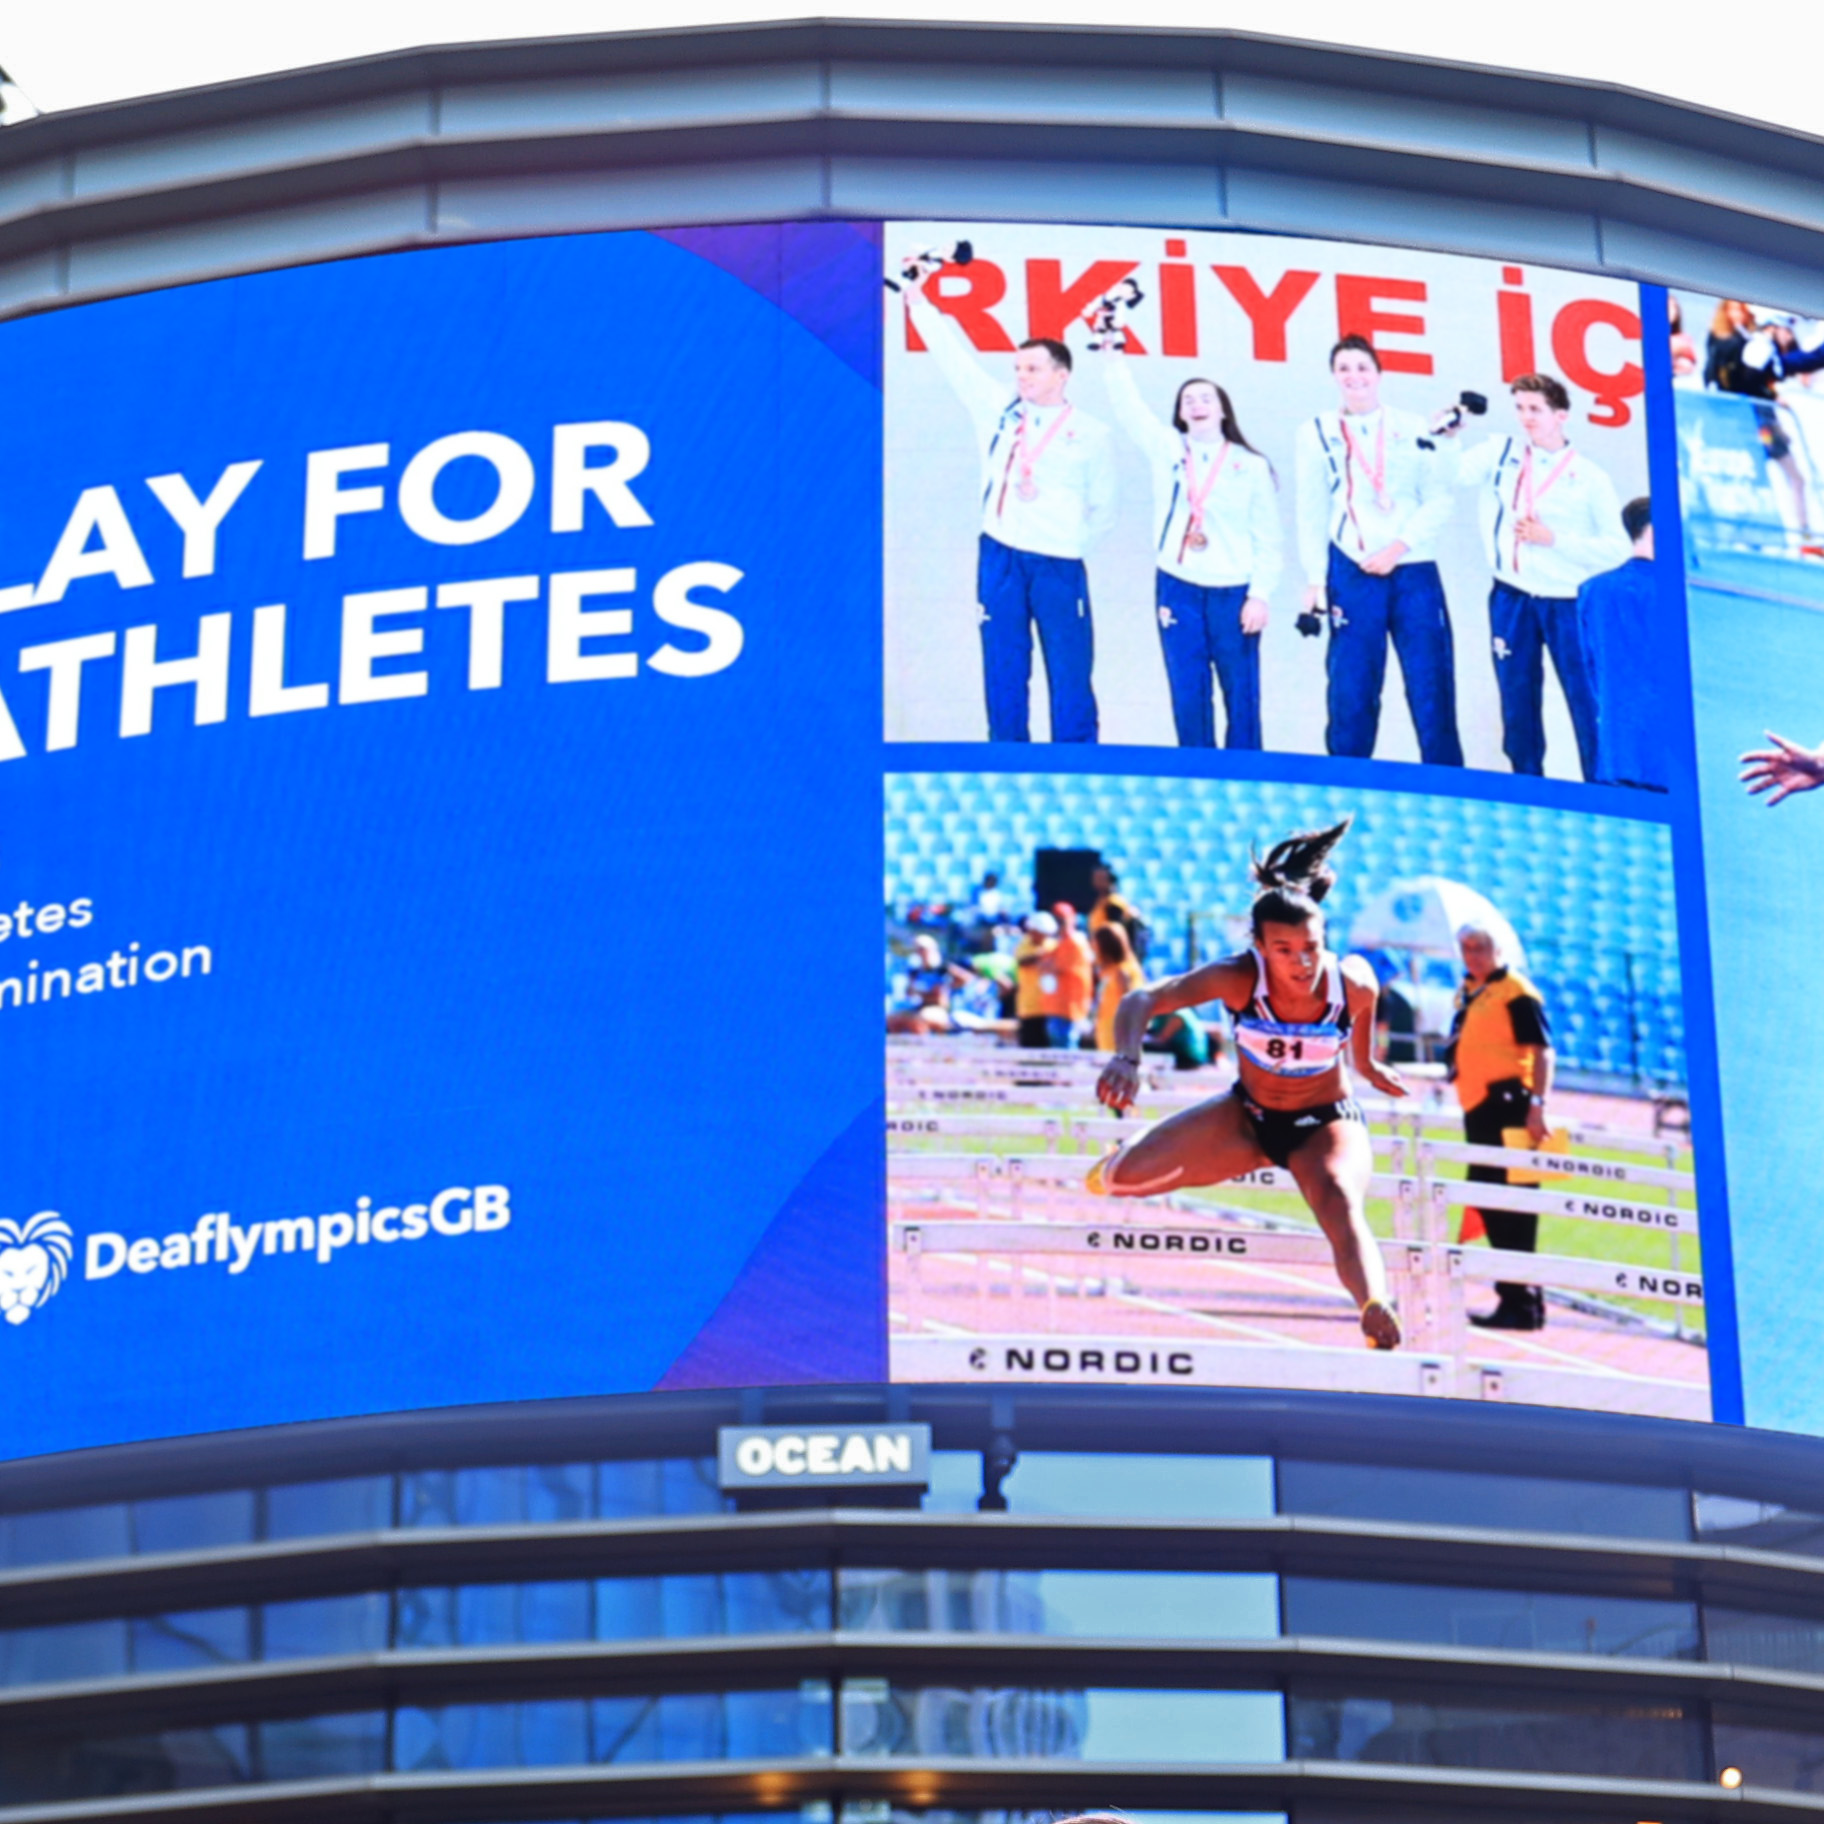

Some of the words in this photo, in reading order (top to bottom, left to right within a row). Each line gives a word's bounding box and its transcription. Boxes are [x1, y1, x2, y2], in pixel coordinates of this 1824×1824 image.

[302, 420, 655, 561] FOR
[1266, 1038, 1303, 1060] 81
[1545, 1156, 1627, 1180] NORDIC
[1583, 1202, 1679, 1228] NORDIC
[84, 1183, 512, 1281] DeaflympicsGB
[1113, 1232, 1248, 1254] NORDIC
[1006, 1348, 1194, 1376] NORDIC
[735, 1433, 912, 1476] OCEAN
